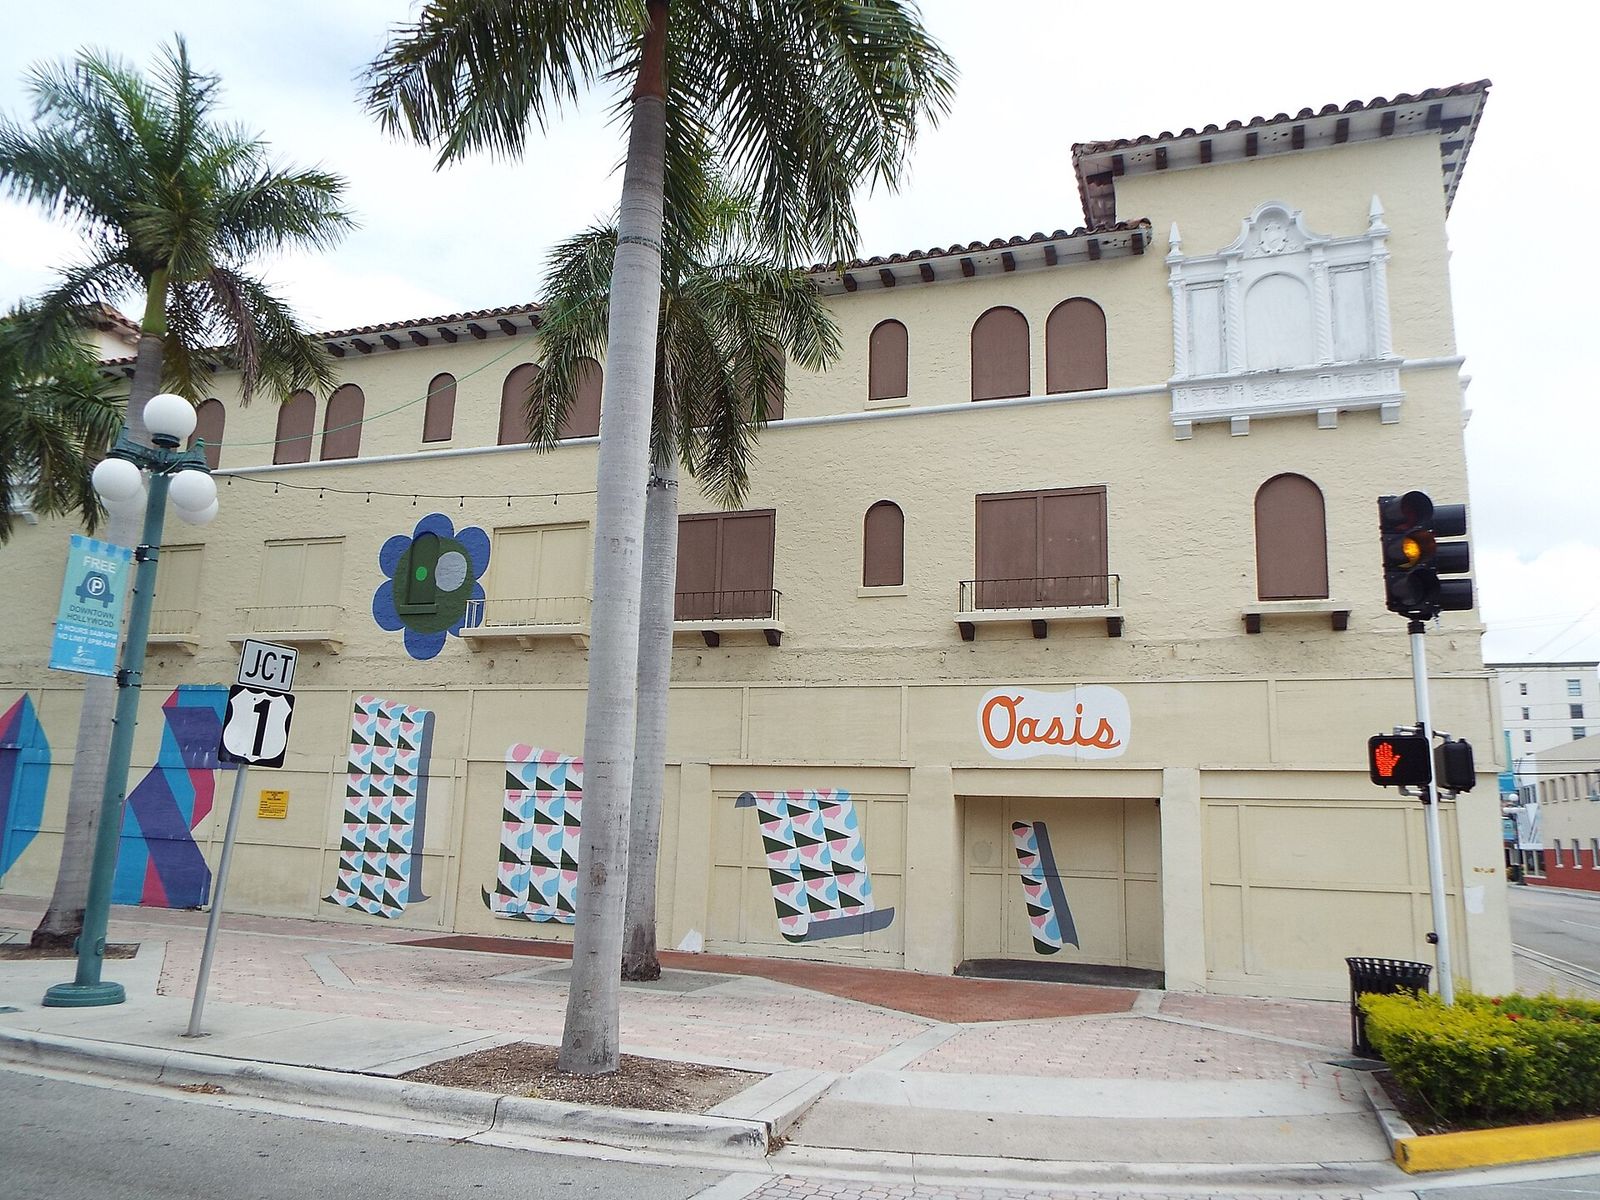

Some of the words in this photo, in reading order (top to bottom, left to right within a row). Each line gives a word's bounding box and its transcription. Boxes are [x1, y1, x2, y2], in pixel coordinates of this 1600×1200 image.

[83, 555, 117, 574] FREE
[91, 579, 103, 593] P
[69, 604, 115, 620] DOWNTOWN
[67, 613, 115, 628] HOLLYWOOD
[57, 632, 69, 641] NO
[69, 634, 87, 643] LIMIT
[64, 625, 89, 635] HOURS
[245, 649, 293, 684] JCT
[252, 698, 272, 757] 1
[982, 695, 1122, 750] Oasis
